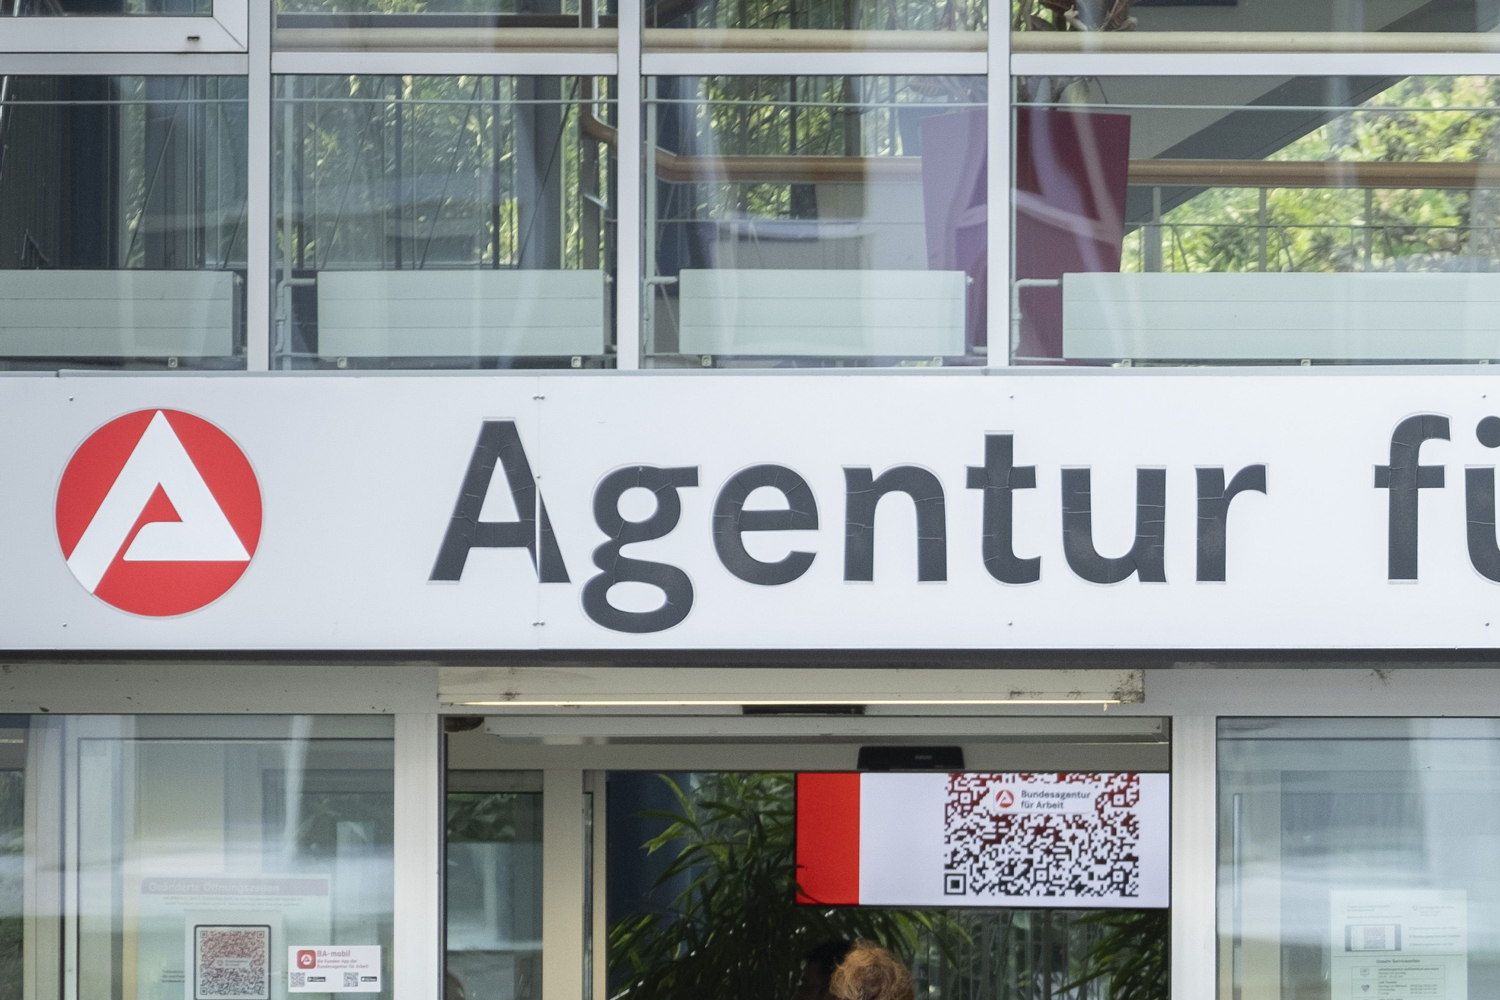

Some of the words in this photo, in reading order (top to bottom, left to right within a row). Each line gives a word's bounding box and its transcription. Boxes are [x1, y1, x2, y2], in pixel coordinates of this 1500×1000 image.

[427, 416, 1269, 633] Agentur
[1021, 789, 1090, 800] Bundesagentur
[1021, 801, 1034, 809] für
[1036, 801, 1064, 809] Arbeit
